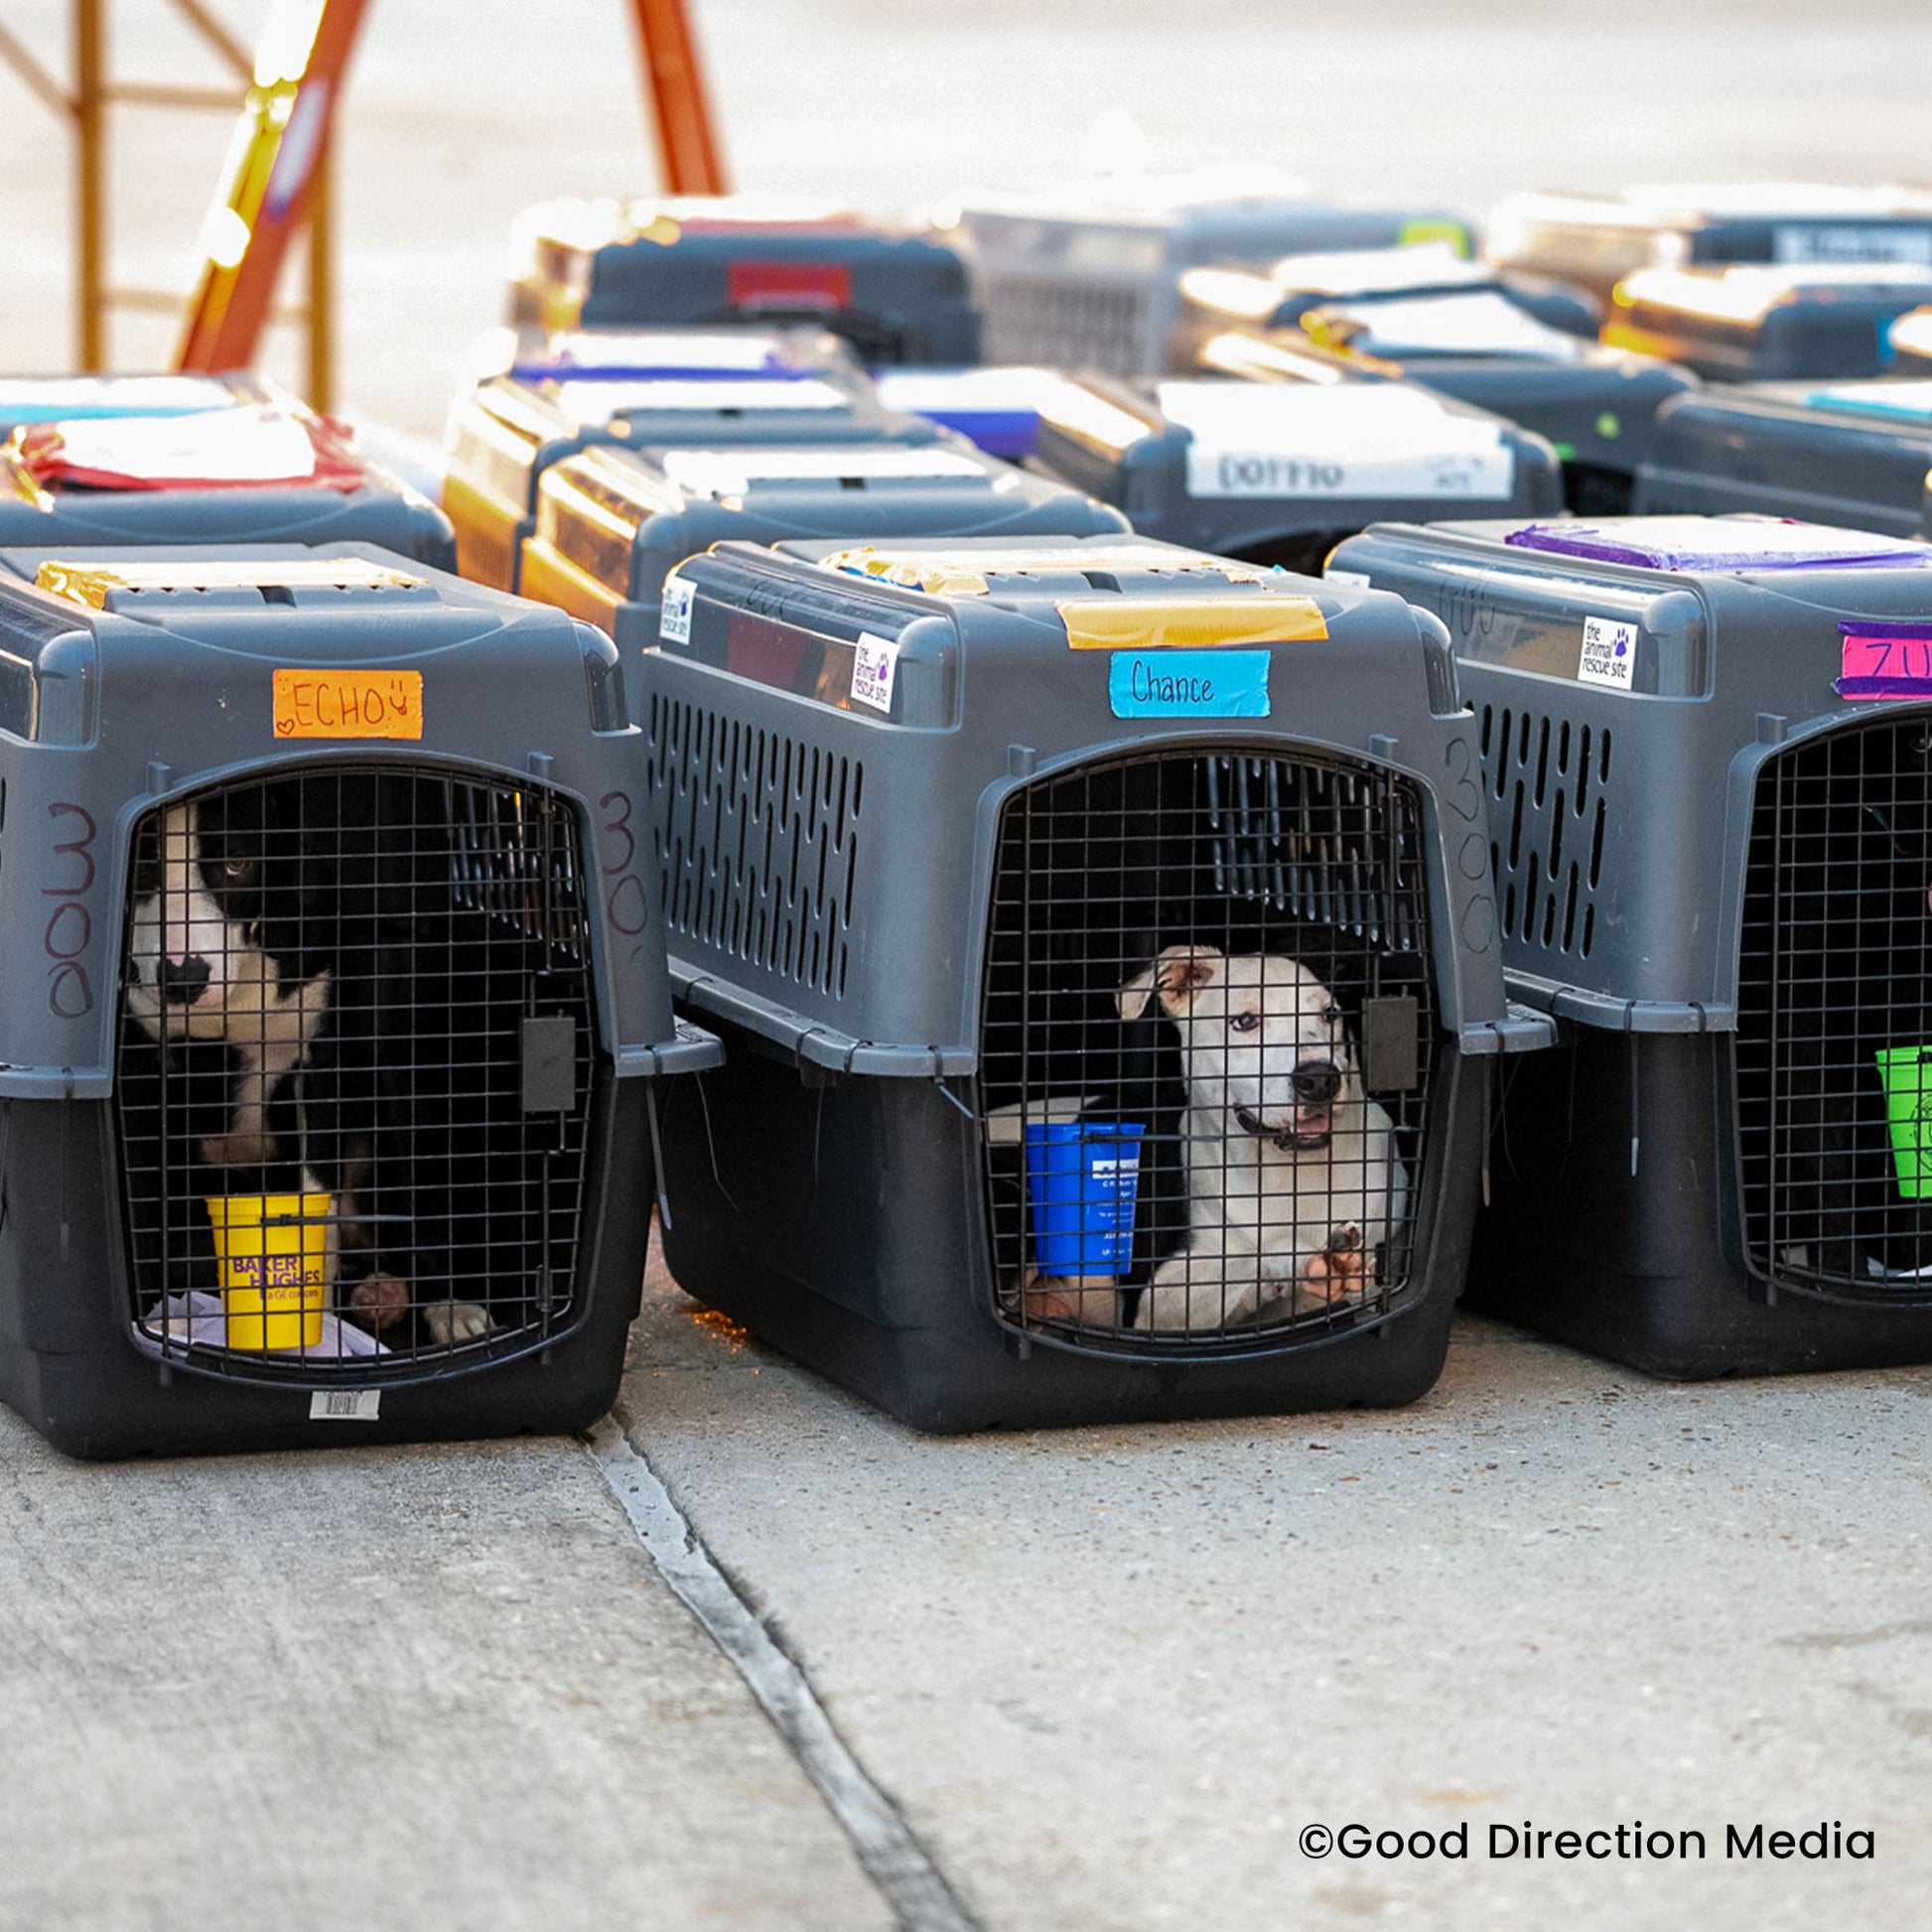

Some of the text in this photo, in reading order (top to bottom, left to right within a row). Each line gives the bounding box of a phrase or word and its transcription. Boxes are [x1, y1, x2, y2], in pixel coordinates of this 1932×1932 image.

[1587, 621, 1600, 641] the
[1585, 640, 1613, 658] animal
[1132, 659, 1215, 704] Chance
[1583, 657, 1627, 678] rescue site
[293, 683, 385, 727] ECHO
[1445, 736, 1494, 955] 300
[42, 801, 97, 1020] 300
[232, 1254, 299, 1274] BAKER
